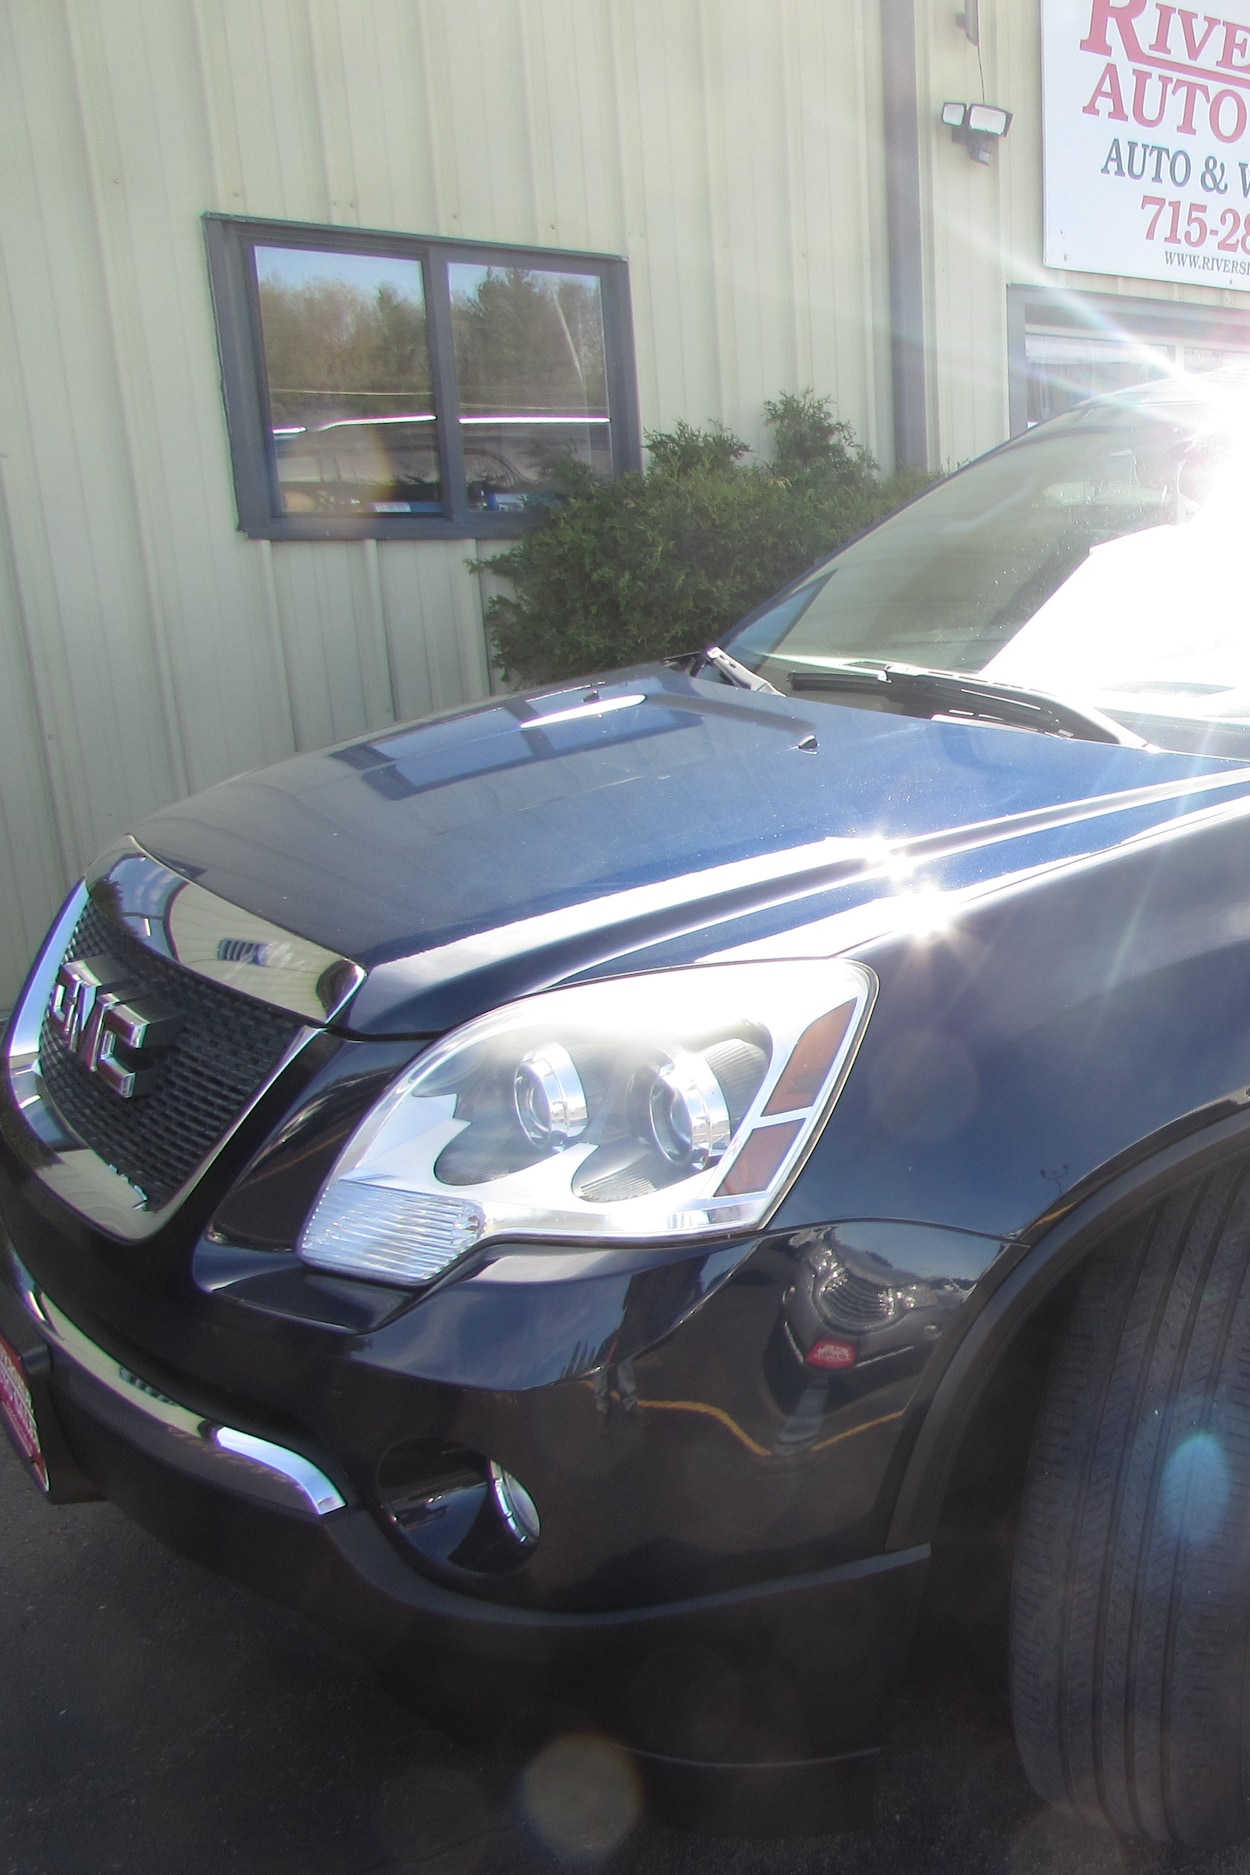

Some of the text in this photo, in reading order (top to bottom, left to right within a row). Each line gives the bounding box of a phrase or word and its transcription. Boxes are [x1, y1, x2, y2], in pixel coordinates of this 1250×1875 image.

[1082, 62, 1248, 144] AUTO
[1101, 138, 1191, 187] AUTO
[1200, 156, 1228, 196] &
[50, 960, 150, 1099] GMC
